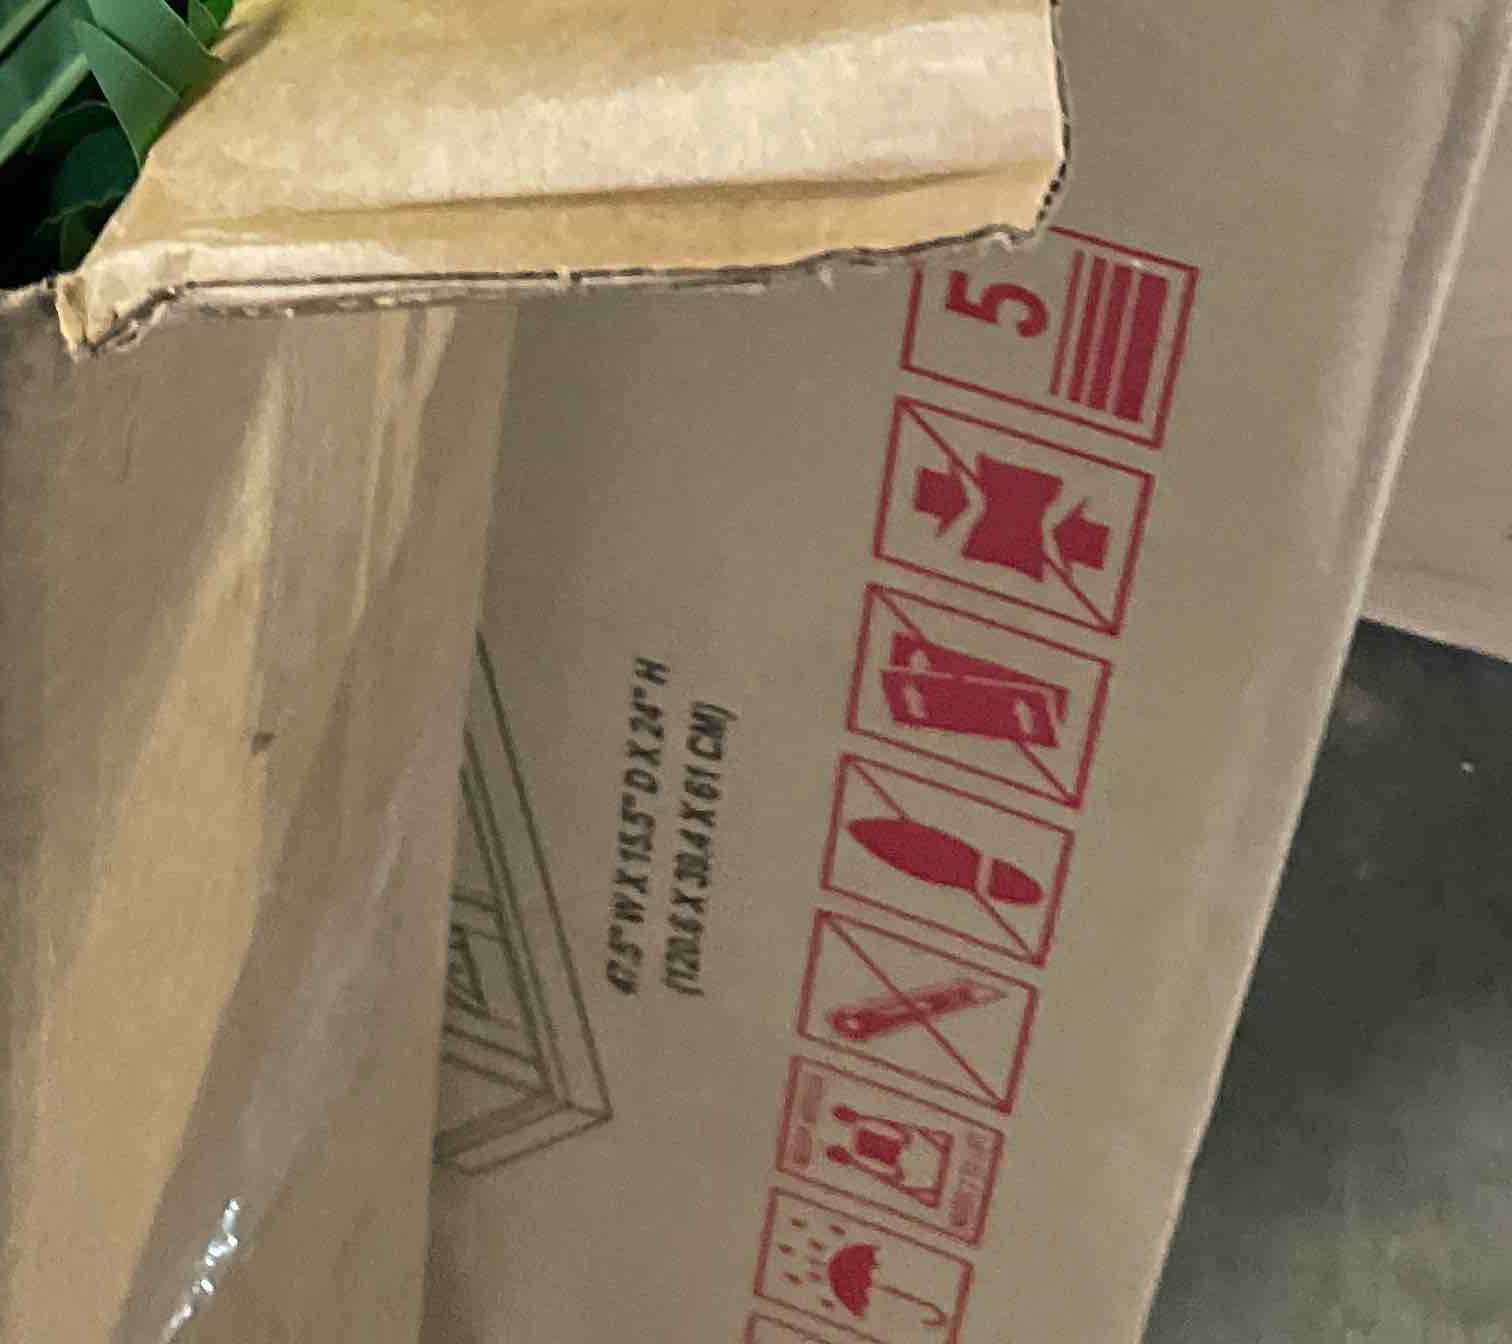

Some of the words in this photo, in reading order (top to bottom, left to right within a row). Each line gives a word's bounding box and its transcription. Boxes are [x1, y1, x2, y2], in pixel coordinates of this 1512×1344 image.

[945, 269, 1049, 338] 5
[635, 657, 671, 686] H
[626, 739, 662, 766] X
[624, 768, 660, 795] D
